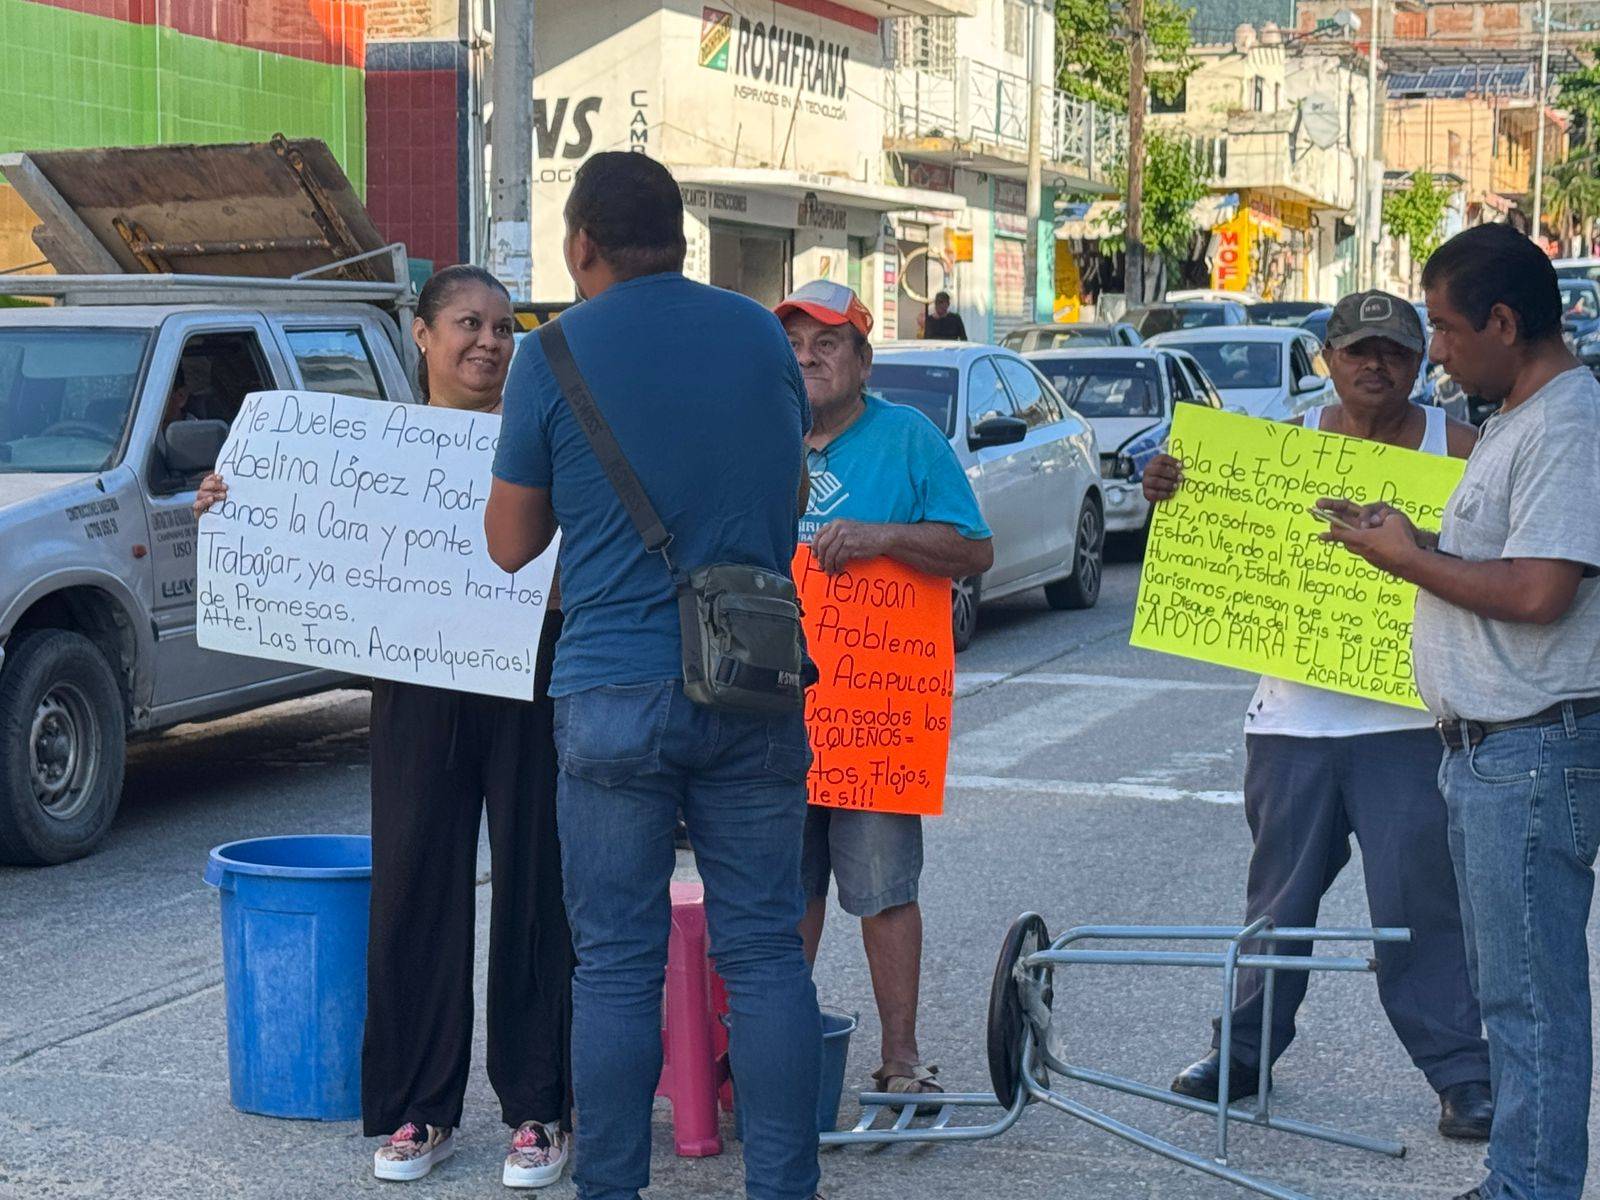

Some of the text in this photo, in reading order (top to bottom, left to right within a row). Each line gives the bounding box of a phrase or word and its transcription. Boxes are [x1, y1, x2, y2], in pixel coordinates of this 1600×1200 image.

[735, 15, 850, 101] ROSHFRANS
[734, 84, 779, 106] INSPIRADOS
[236, 396, 270, 434] Me
[270, 395, 367, 440] Dueles
[218, 439, 319, 486] Abelina
[330, 450, 409, 509] López
[1180, 479, 1304, 515] rogantes. Como
[1219, 451, 1246, 482] de
[1252, 457, 1367, 502] Empleados
[288, 492, 307, 535] la
[318, 500, 369, 543] Cara
[404, 524, 474, 567] ponte
[1153, 519, 1204, 547] Están
[1209, 529, 1264, 559] Viendo
[1268, 542, 1283, 566] al
[1287, 544, 1342, 575] Pueblo
[1198, 510, 1276, 539] nosotros
[1285, 517, 1301, 543] la
[201, 531, 302, 588] Trabajar,
[308, 560, 335, 590] ya
[345, 563, 452, 596] estamos
[465, 568, 544, 606] hartos
[1244, 559, 1290, 590] Están
[1297, 570, 1368, 605] llegando
[1377, 586, 1402, 606] los
[200, 580, 356, 623] de Promesas.
[1232, 590, 1289, 615] piensan
[1293, 604, 1322, 622] que
[1331, 611, 1363, 627] uno
[203, 607, 531, 681] Atte. Las Fam. Acapulqueñas!
[815, 604, 937, 659] Problema
[1227, 622, 1285, 660] PARA
[1294, 636, 1326, 668] EL
[1266, 611, 1288, 631] del
[1370, 636, 1399, 652] una
[924, 702, 947, 732] los
[868, 755, 931, 796] Flojos,
